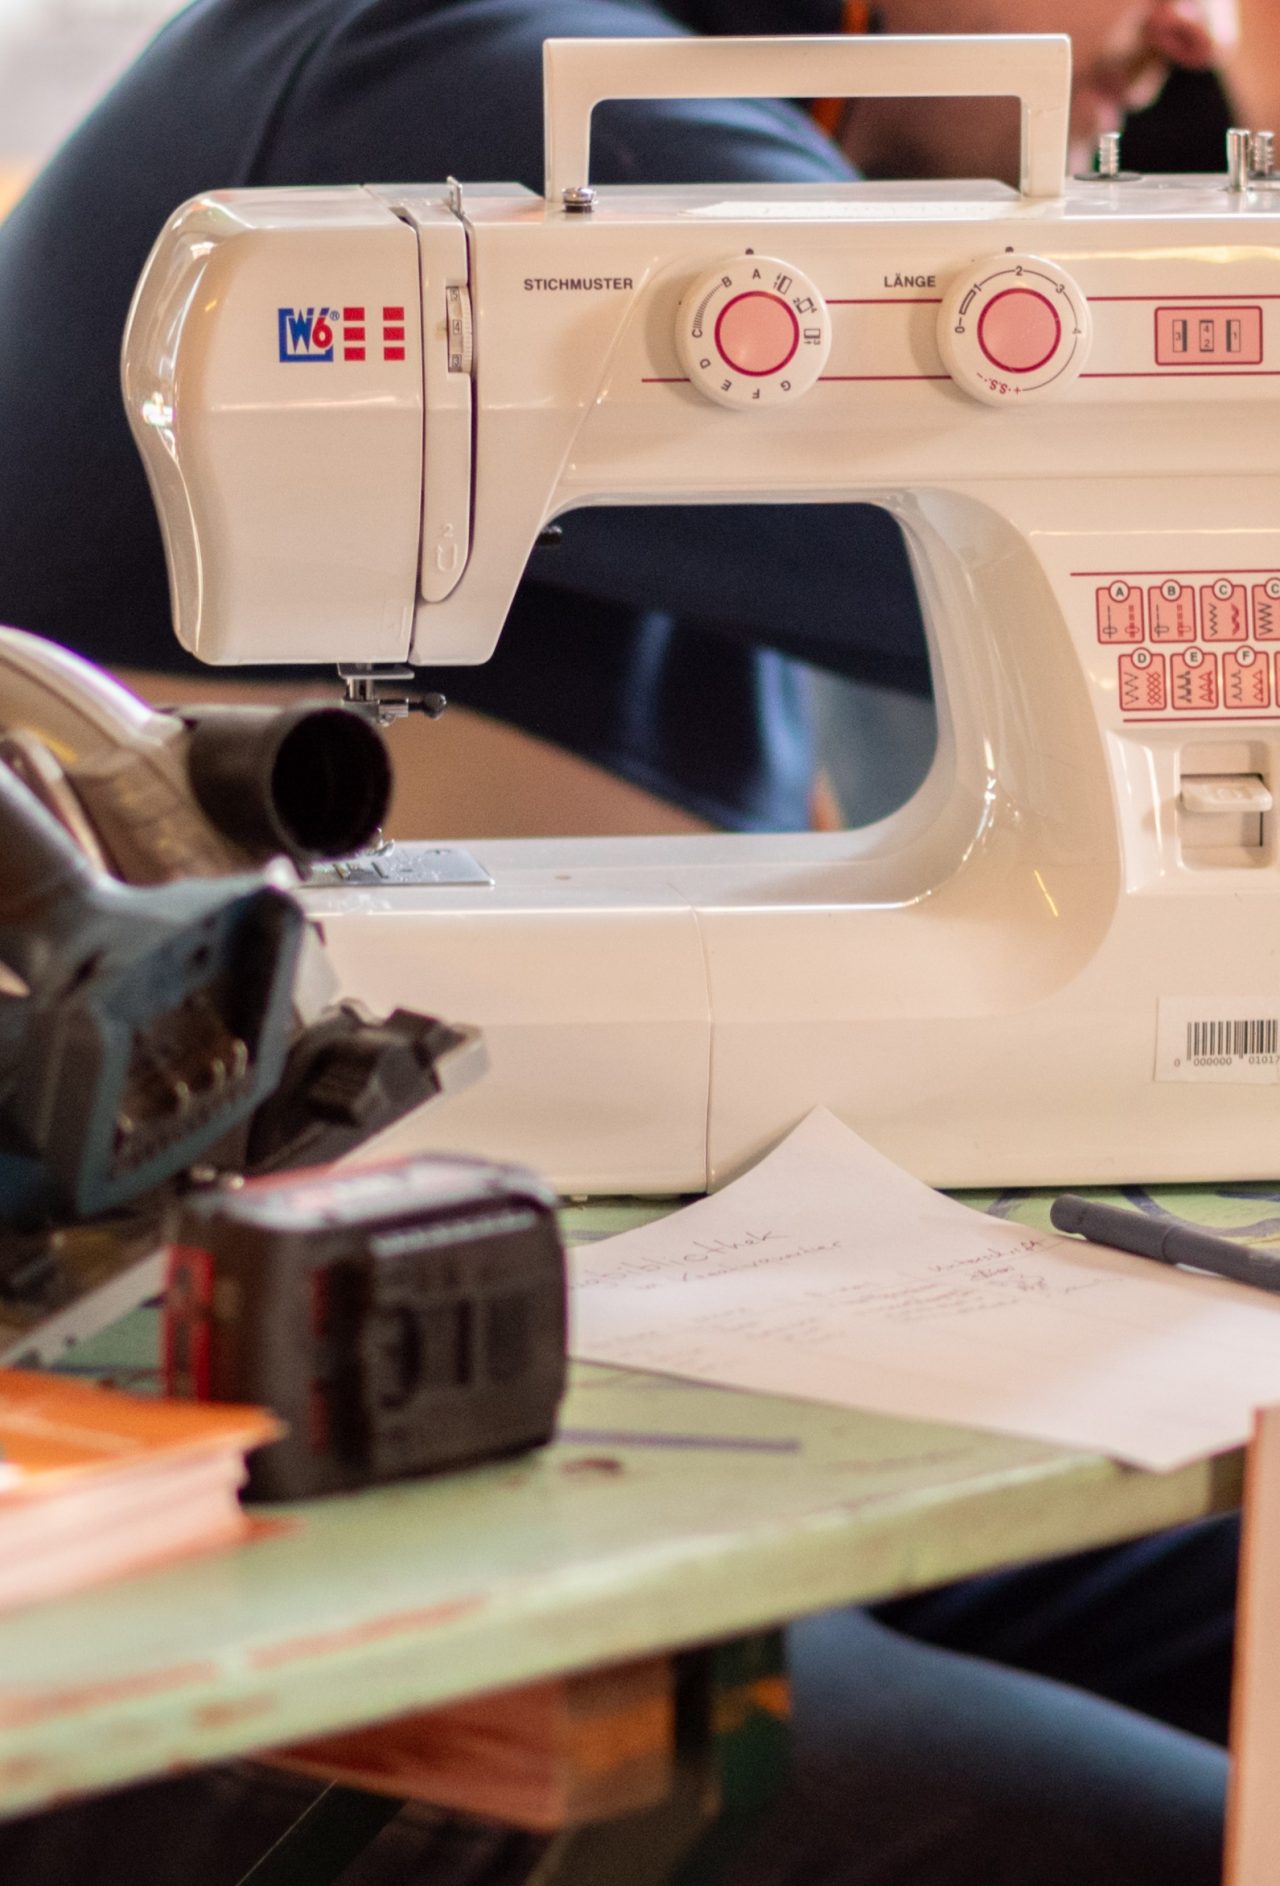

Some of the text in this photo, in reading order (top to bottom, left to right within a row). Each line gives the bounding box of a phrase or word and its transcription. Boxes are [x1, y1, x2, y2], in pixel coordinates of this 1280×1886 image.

[523, 277, 634, 292] STICHMUSTER
[883, 273, 937, 289] LÄNGE
[1015, 265, 1024, 277] 2
[1055, 283, 1065, 294] 3
[691, 268, 792, 400] A B C D E F G
[1115, 583, 1280, 597] A B C C
[1137, 650, 1251, 664] D E F
